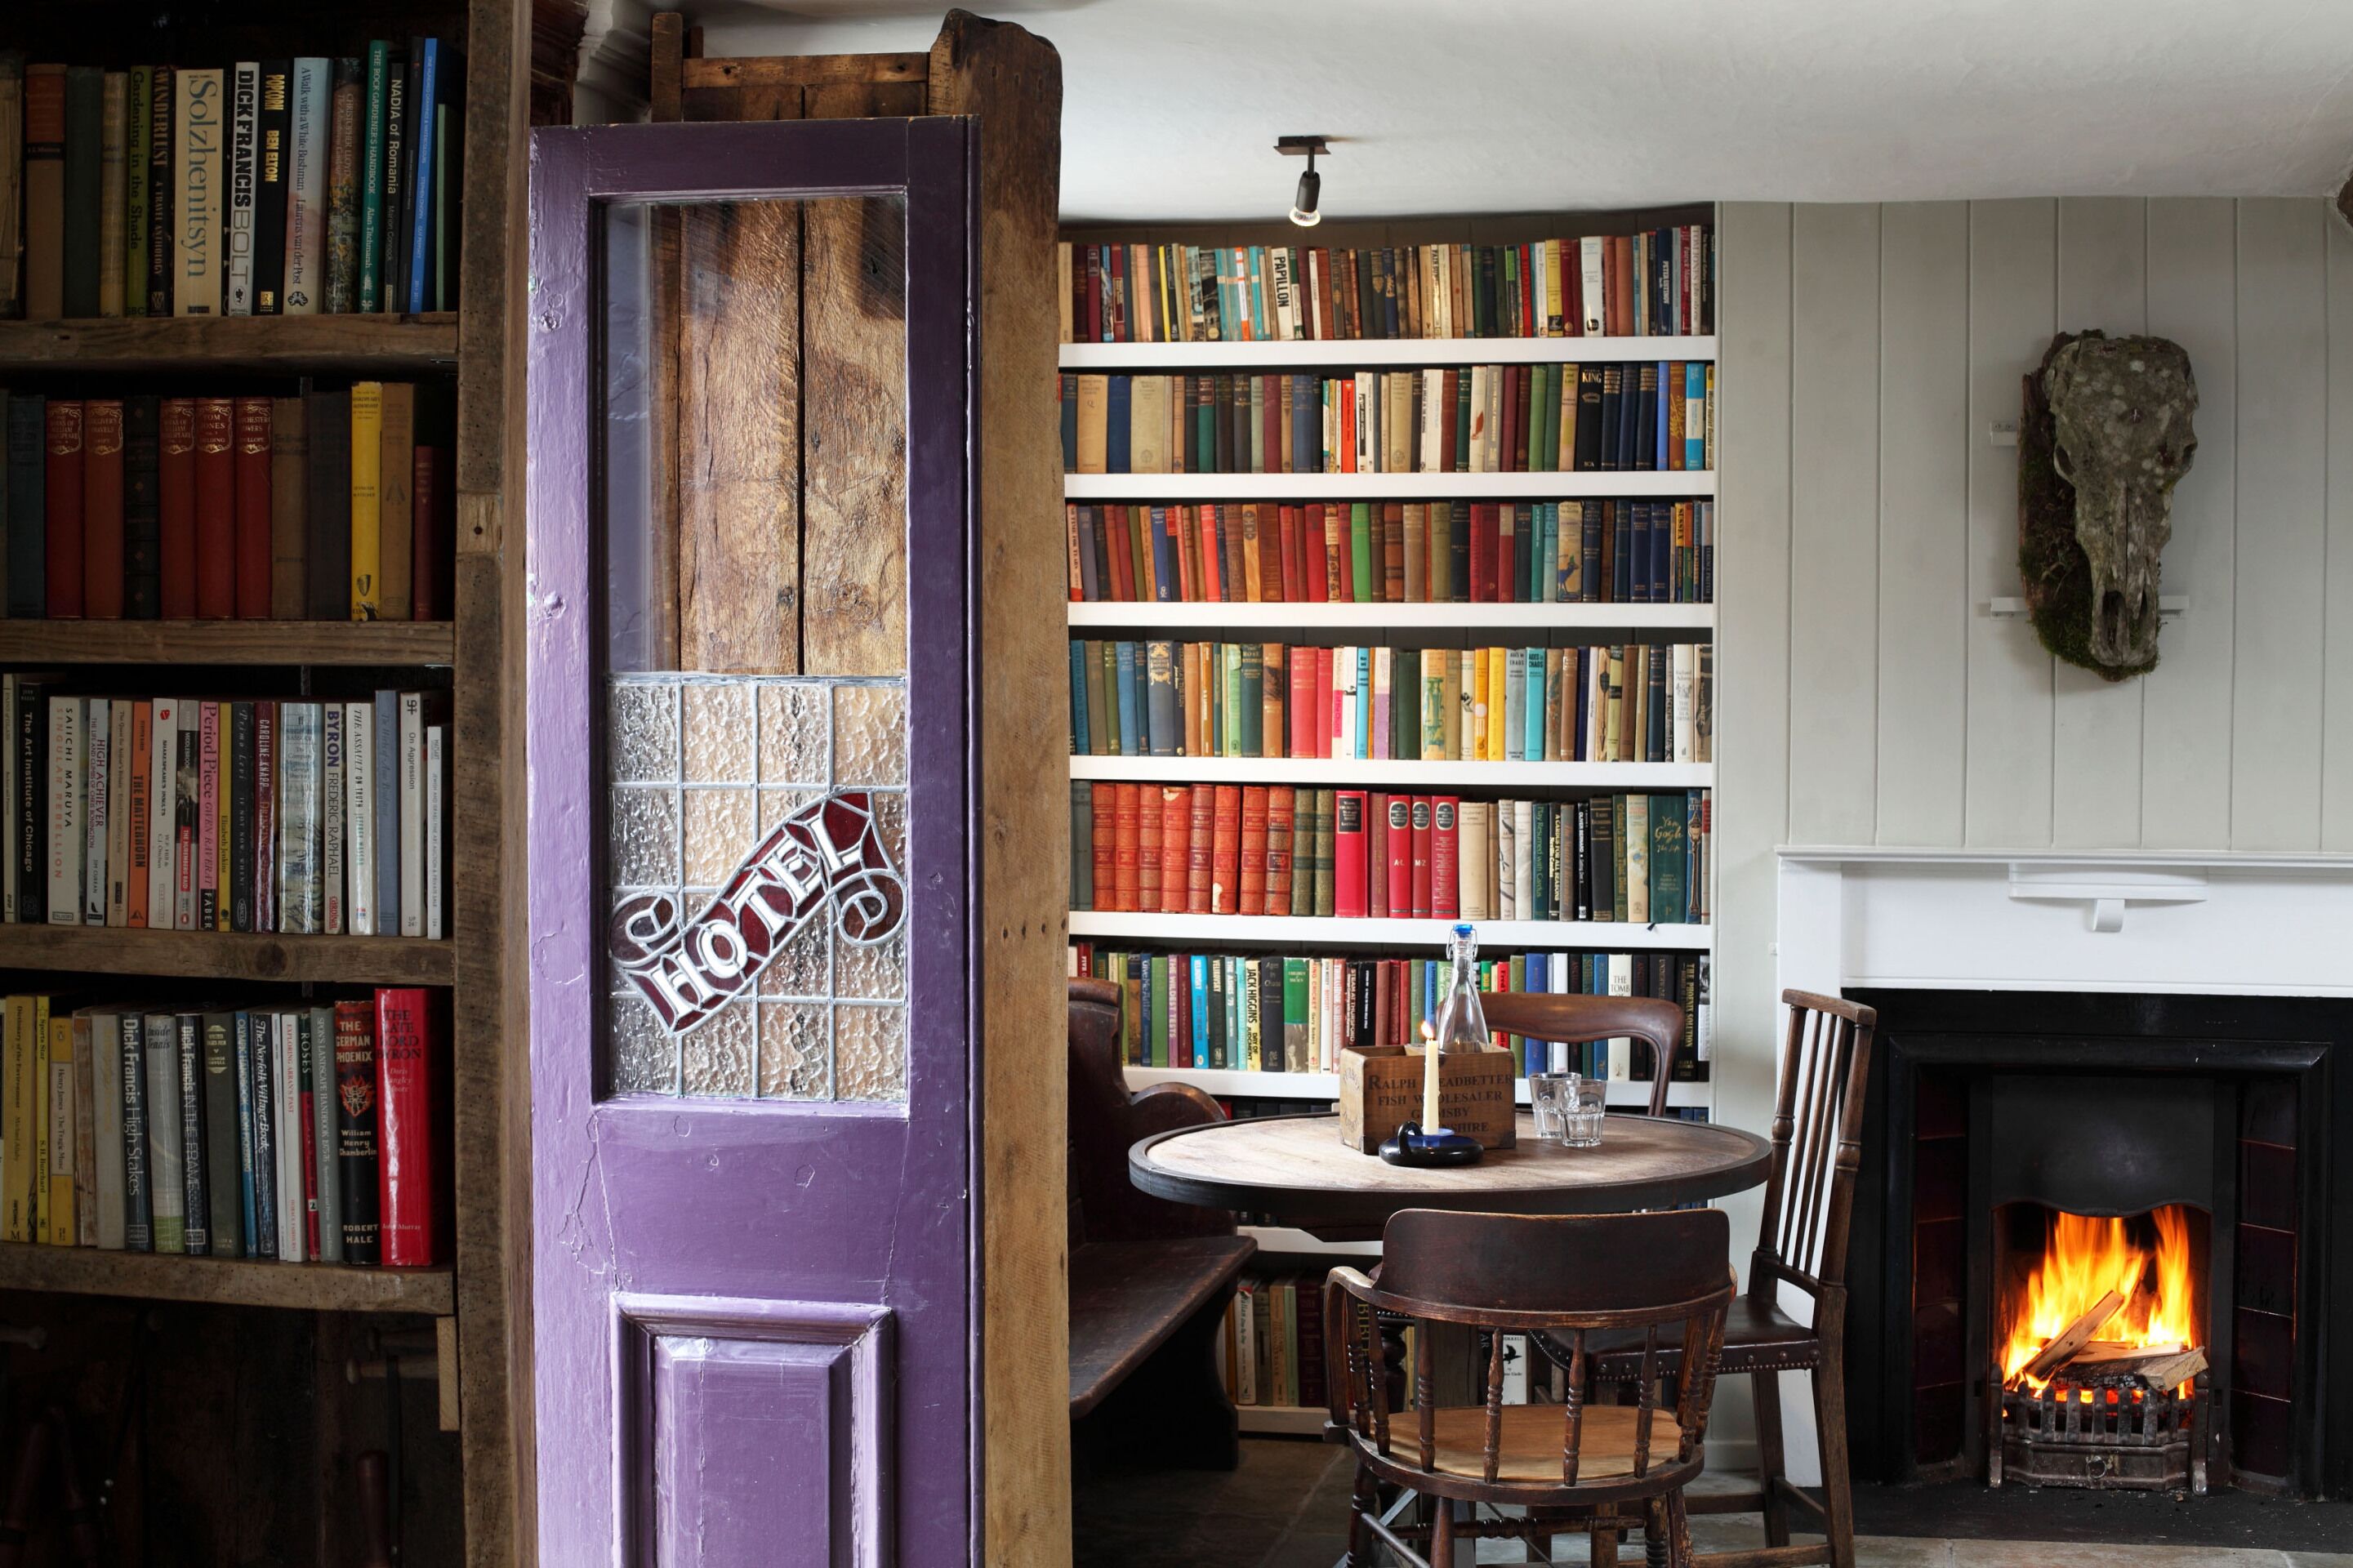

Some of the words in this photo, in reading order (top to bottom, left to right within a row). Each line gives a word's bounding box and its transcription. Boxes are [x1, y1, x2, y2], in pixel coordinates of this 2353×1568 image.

[372, 50, 382, 67] THE
[236, 70, 254, 117] DICK
[264, 74, 286, 111] POPCORN
[300, 74, 311, 95] Walk
[372, 69, 381, 91] ROCK
[131, 72, 145, 148] Gardening
[299, 96, 310, 115] with
[390, 79, 402, 120] NADIA
[153, 67, 170, 167] WANDERLUST
[344, 93, 354, 147] CHRISTOPHER
[389, 123, 399, 136] of
[265, 130, 280, 149] BEN
[297, 122, 309, 149] White
[131, 154, 144, 168] in
[234, 119, 252, 207] FRANCIS
[264, 151, 279, 183] ELTON
[296, 149, 308, 191] Bushman
[343, 149, 353, 177] LLOYD
[368, 146, 378, 194] HANDBOOK
[387, 140, 399, 194] Romania
[130, 176, 144, 198] the
[180, 79, 217, 278] Solzhenitsyn
[154, 191, 164, 222] TRAVEL
[294, 198, 306, 233] Laurens
[367, 207, 376, 225] Alan
[130, 206, 143, 249] Shade
[294, 234, 303, 249] van
[231, 209, 251, 285] BOLT
[293, 252, 304, 266] der
[364, 226, 374, 268] Titchmarsh
[292, 267, 303, 285] Post
[1273, 256, 1290, 308] PAPILLON
[1580, 372, 1602, 384] KING
[25, 712, 33, 734] The
[203, 705, 217, 755] Period
[238, 710, 248, 748] Primo
[353, 709, 363, 728] THE
[25, 737, 33, 756] Art
[56, 707, 65, 785] SINGULAR
[65, 707, 73, 761] SAIICHI
[259, 719, 271, 758] CAROLINE
[327, 710, 341, 768] BYRON
[408, 732, 417, 744] On
[96, 739, 105, 768] HIGH
[353, 731, 363, 773] ASSAULT
[202, 758, 216, 799] Piece
[237, 754, 247, 782] Levi
[259, 761, 270, 788] KNAPP
[406, 746, 417, 791] Aggression
[25, 760, 33, 808] Institute
[65, 770, 73, 827] MARUYA
[133, 775, 145, 793] THE
[328, 772, 340, 823] FREDERIC
[354, 787, 363, 808] TRUTH
[96, 772, 105, 826] ACHIEVER
[1536, 807, 1544, 820] Play
[25, 810, 33, 823] of
[204, 801, 213, 832] GWEN
[221, 815, 229, 847] Elizabeth
[54, 792, 63, 879] REBELLION
[133, 796, 146, 867] MATTERHORN
[1536, 822, 1544, 855] Resumed
[1655, 826, 1684, 844] Gogh
[24, 825, 33, 873] Chicago
[203, 836, 214, 887] RAVERAT
[221, 848, 229, 873] Jenkins
[328, 826, 340, 879] RAPHAEL
[1535, 872, 1544, 898] Cardus
[203, 891, 213, 929] FABER
[651, 817, 863, 1018] HOTEL
[1169, 957, 1177, 973] THE
[1246, 968, 1257, 988] JACK
[1614, 975, 1629, 984] THE
[1686, 963, 1695, 978] THE
[1169, 975, 1177, 1012] WILDEST
[1611, 984, 1631, 993] TOMB
[1685, 981, 1695, 1011] PHOENIX
[385, 1009, 411, 1021] THE
[1247, 990, 1258, 1023] HIGGINS
[16, 1005, 24, 1042] Dictionary
[38, 1018, 47, 1043] Sports
[123, 1018, 139, 1051] Dick
[237, 1018, 247, 1055] OLYMPIC
[255, 1020, 267, 1043] The
[316, 1018, 327, 1043] SPON'S
[338, 1021, 362, 1032] THE
[384, 1022, 415, 1034] LATE
[1169, 1014, 1177, 1038] TESTS
[1684, 1013, 1693, 1049] SOLUTION
[146, 1037, 172, 1049] Tennis
[180, 1026, 195, 1051] Dick
[286, 1023, 294, 1064] EXPLORING
[301, 1031, 311, 1075] ROSES
[336, 1035, 370, 1047] GERMAN
[381, 1036, 420, 1048] LORD
[1252, 1045, 1259, 1055] OF
[256, 1044, 269, 1083] Norfolk
[317, 1045, 328, 1091] LANDSCAPE
[336, 1051, 372, 1063] PHOENIX
[377, 1049, 422, 1061] BYRON
[57, 1068, 65, 1090] Henry
[124, 1061, 140, 1104] Francis
[182, 1053, 196, 1092] Francis
[238, 1054, 249, 1105] HANDBOOK
[287, 1066, 295, 1095] ARRAN'S
[1368, 1075, 1416, 1090] RALPH
[57, 1090, 65, 1111] James
[183, 1094, 197, 1109] IN
[257, 1084, 269, 1120] Village
[1378, 1095, 1406, 1106] FISH
[1414, 1090, 1503, 1105] WOLESALER
[123, 1107, 143, 1144] High
[184, 1110, 198, 1138] THE
[319, 1093, 330, 1138] HANDBOOK
[1410, 1107, 1469, 1119] GMSBY
[57, 1128, 65, 1151] Tragic
[258, 1122, 270, 1153] Book
[341, 1129, 372, 1138] William
[343, 1138, 370, 1148] Henry
[339, 1147, 377, 1157] Chamberlin
[127, 1146, 144, 1196] Stakes
[185, 1143, 200, 1191] FRAME
[342, 1223, 379, 1232] ROBERT
[345, 1235, 374, 1244] HALE
[396, 1223, 422, 1231] Murray
